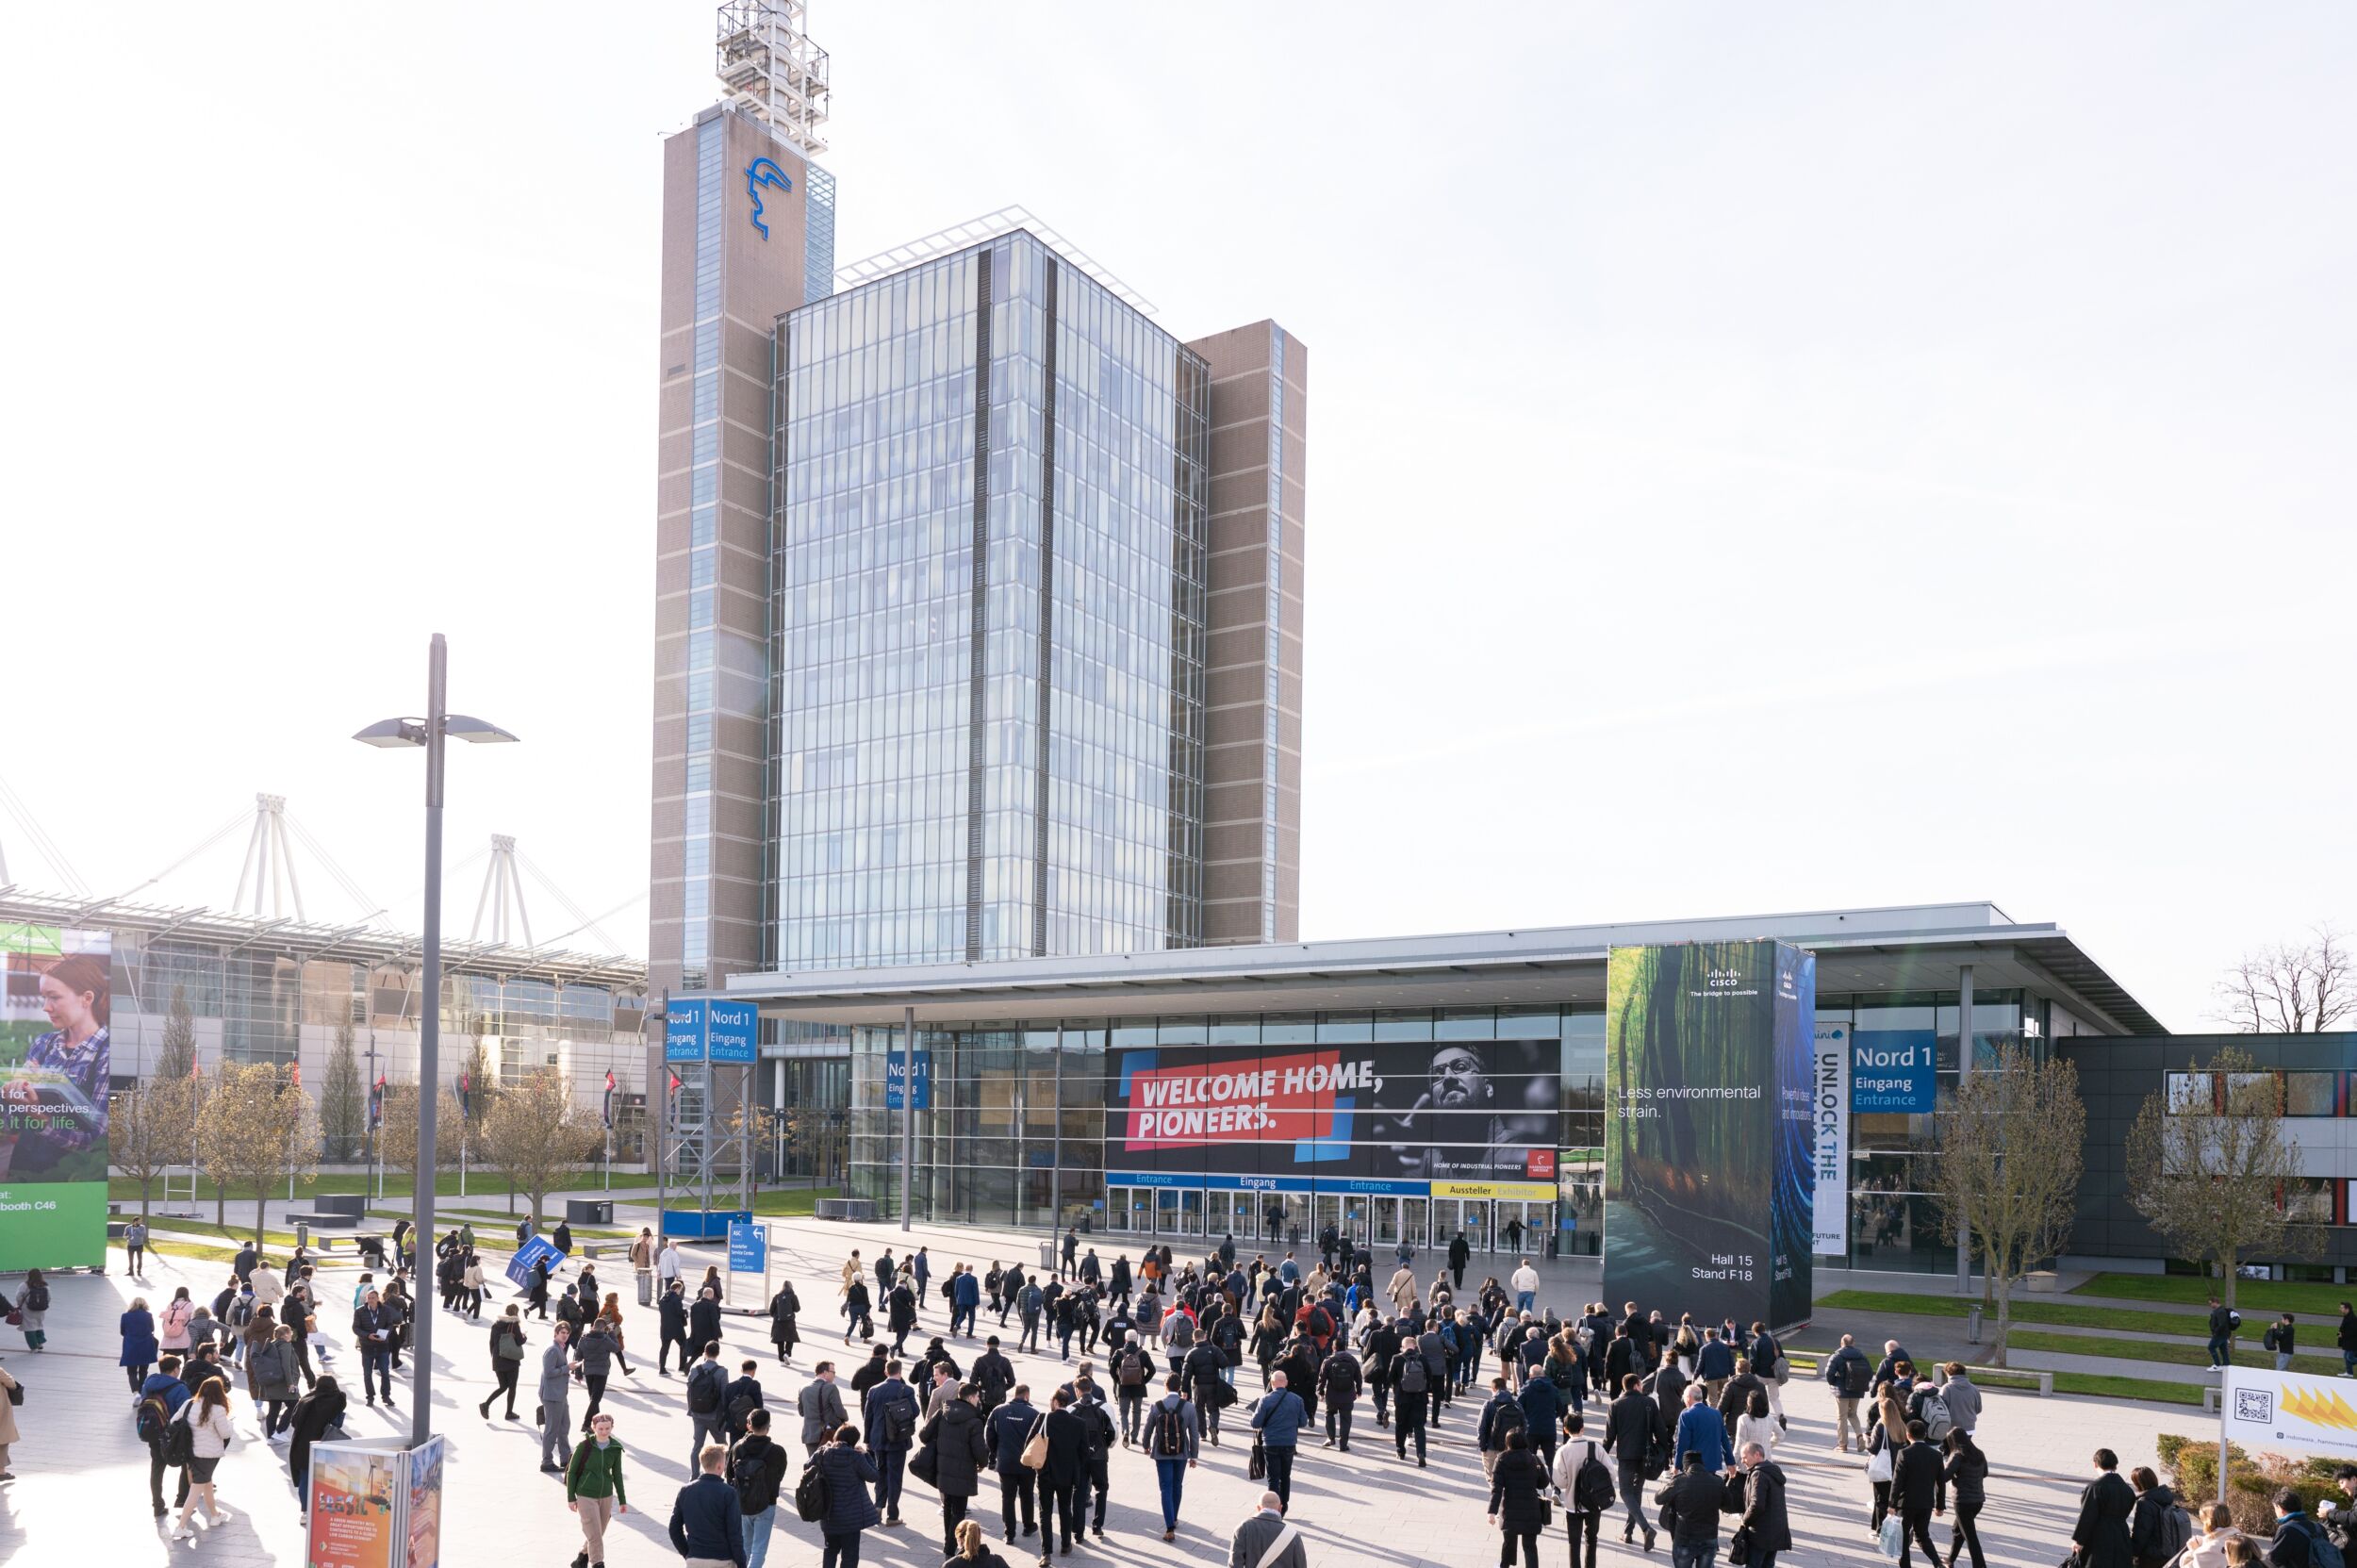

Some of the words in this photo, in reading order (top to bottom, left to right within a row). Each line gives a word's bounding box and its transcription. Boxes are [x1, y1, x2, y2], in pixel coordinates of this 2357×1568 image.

[1731, 989, 1758, 998] possible
[694, 1010, 699, 1024] 1
[711, 1010, 740, 1026] Nord
[744, 1013, 749, 1027] 1
[710, 1032, 746, 1047] Eingang
[710, 1046, 749, 1057] Entrance
[1855, 1046, 1915, 1067] Nord
[1921, 1047, 1931, 1066] 1
[889, 1062, 918, 1076] Nod
[921, 1063, 927, 1076] 1
[888, 1083, 917, 1095] Eingg
[1142, 1069, 1277, 1107] WELCOME
[1283, 1060, 1383, 1095] HOME,
[1855, 1077, 1913, 1092] Eingang
[8, 1088, 27, 1098] for
[1618, 1086, 1652, 1098] Less
[1656, 1085, 1761, 1099] environmental
[1821, 1053, 1838, 1136] UNLOCK
[888, 1095, 920, 1104] Entrce
[1855, 1094, 1917, 1106] Entrance
[8, 1102, 90, 1114] perspectives
[1618, 1105, 1661, 1118] strain.
[9, 1116, 19, 1130] it
[24, 1116, 47, 1130] for
[52, 1116, 79, 1130] life.
[1138, 1102, 1277, 1138] PIONEERS.
[1820, 1146, 1838, 1180] THE
[1136, 1175, 1173, 1184] Entrance
[1240, 1177, 1276, 1190] Eingang
[1350, 1180, 1392, 1192] Entrance
[1450, 1185, 1492, 1195] Aussteller
[1497, 1187, 1537, 1197] Exhibitor
[0, 1202, 31, 1211] booth
[35, 1201, 57, 1210] C46
[1711, 1253, 1733, 1265] Hall
[1738, 1255, 1753, 1265] 15
[1692, 1267, 1726, 1279] Stand
[1729, 1269, 1753, 1281] F18
